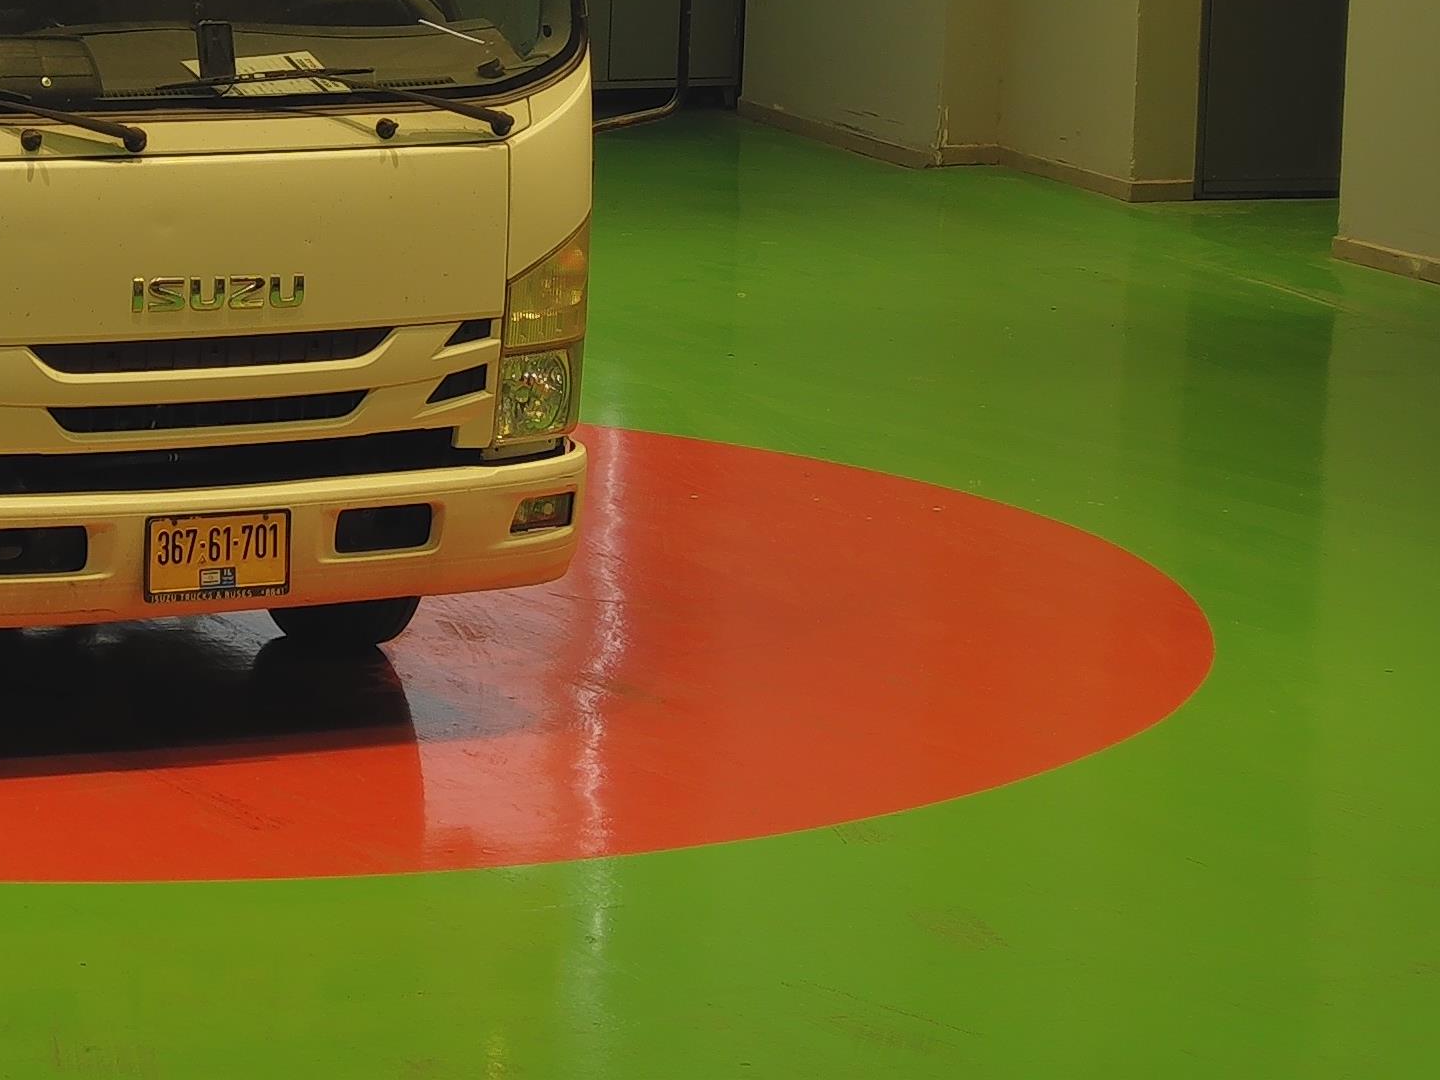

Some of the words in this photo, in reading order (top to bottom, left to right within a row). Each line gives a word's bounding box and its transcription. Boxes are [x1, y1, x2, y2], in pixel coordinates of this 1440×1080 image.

[132, 272, 305, 313] ISUZU
[223, 568, 232, 576] IL
[151, 593, 177, 603] ISUZU
[180, 592, 213, 601] TRUCKS
[225, 589, 253, 599] BUSES
